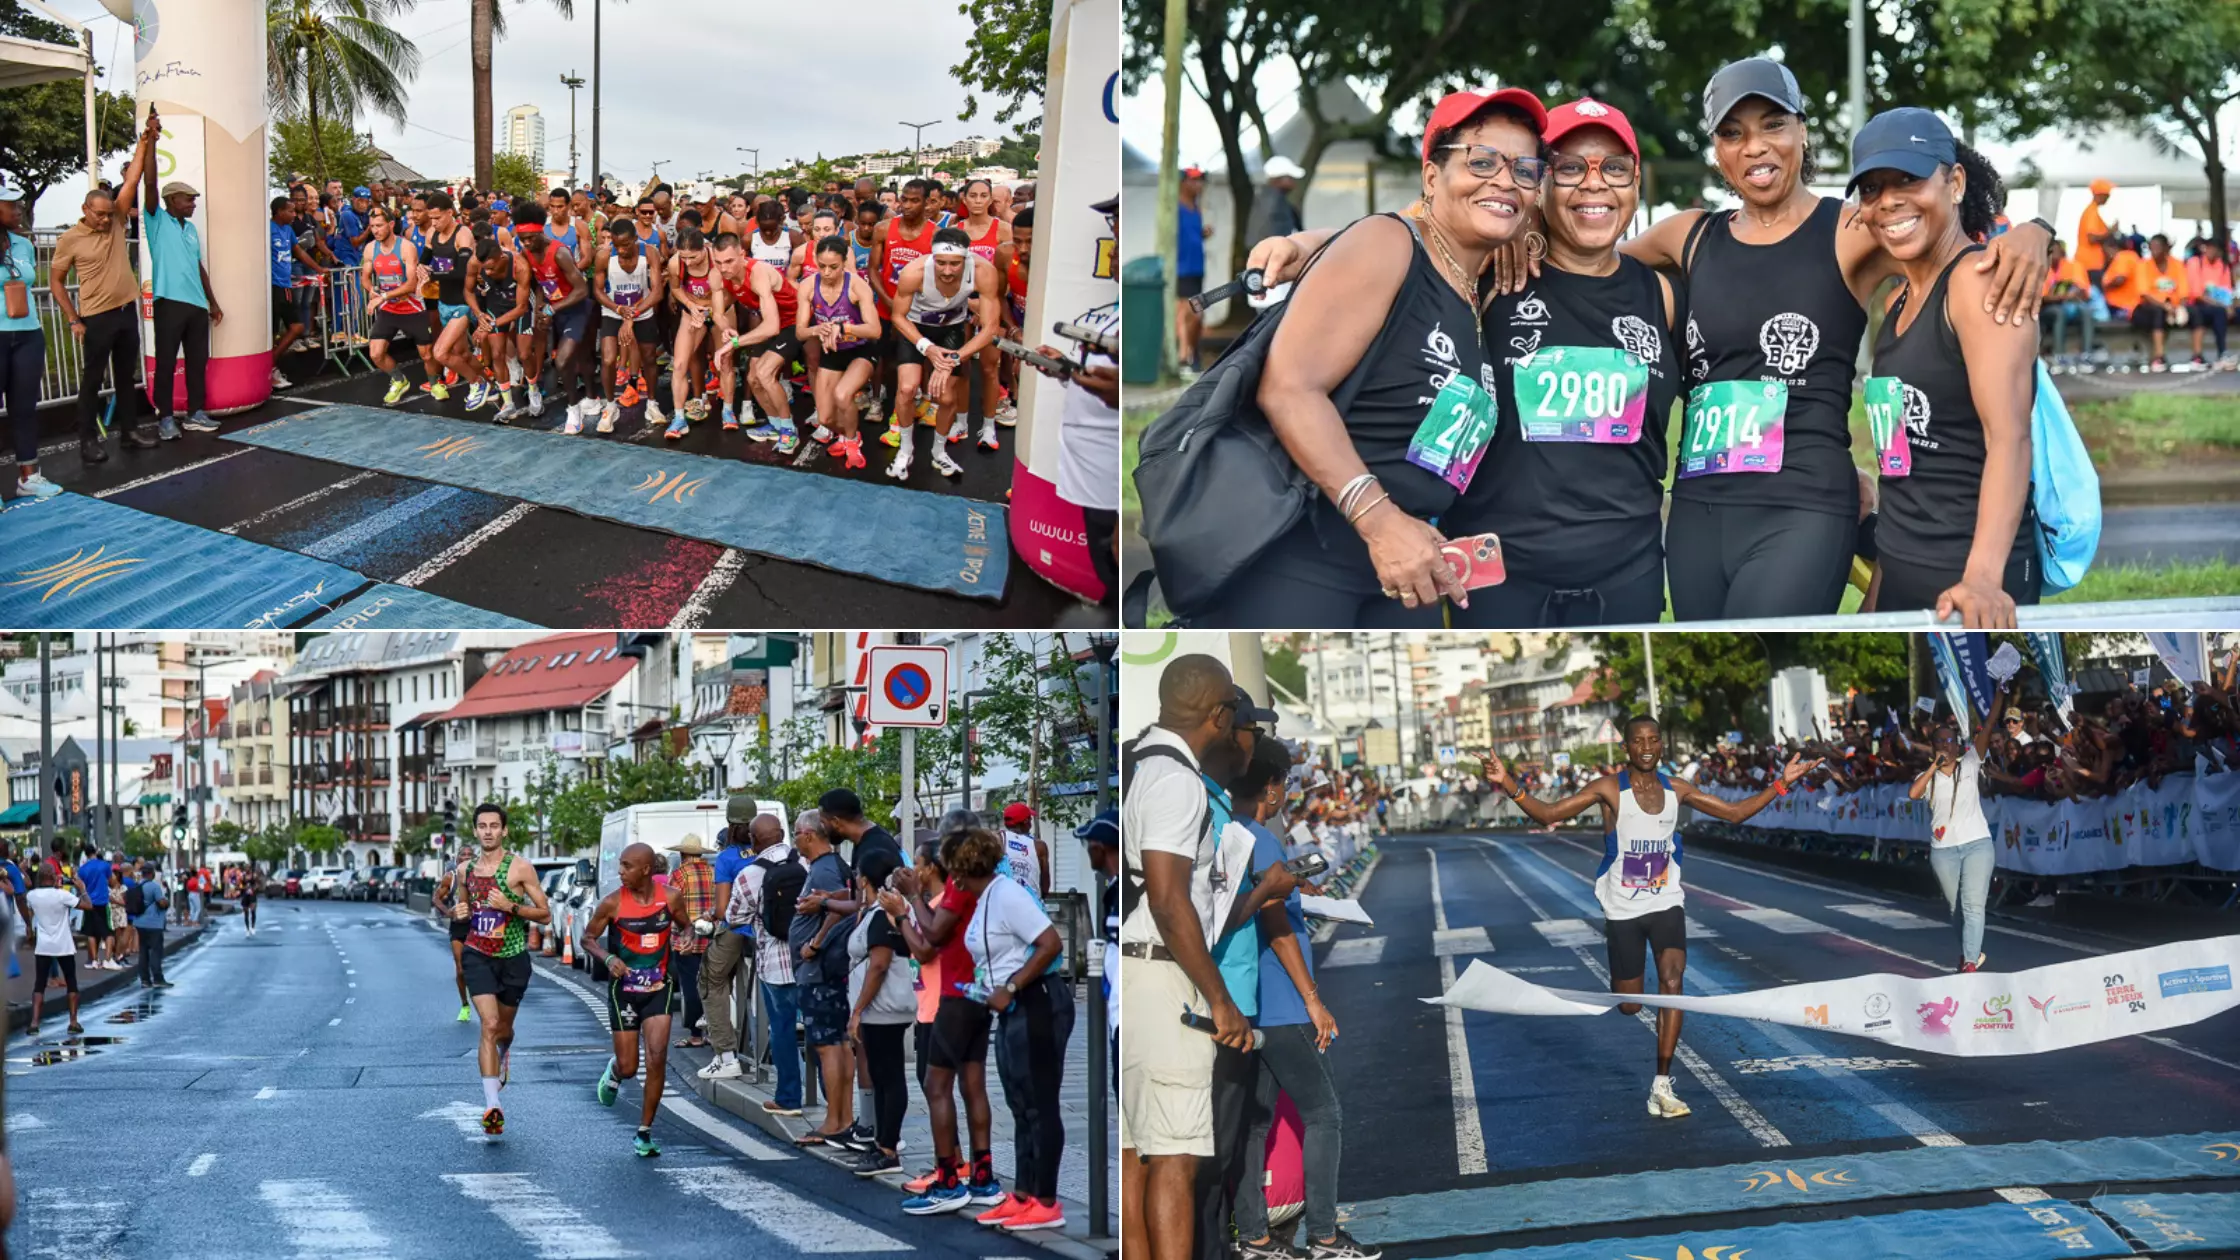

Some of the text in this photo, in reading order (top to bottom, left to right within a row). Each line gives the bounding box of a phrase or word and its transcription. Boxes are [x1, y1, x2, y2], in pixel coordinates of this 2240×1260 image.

[1624, 337, 1660, 363] BCT
[1768, 346, 1811, 373] BCT
[1536, 370, 1628, 419] 2980
[1691, 403, 1763, 453] 2914
[1630, 839, 1668, 852] VIRTUS
[1644, 861, 1652, 880] 1
[477, 917, 496, 932] 117
[2162, 976, 2188, 988] Active
[2195, 972, 2229, 986] Sportive
[2105, 983, 2136, 998] TERRE
[2106, 991, 2144, 1005] DE JEUX
[2128, 1000, 2147, 1013] 24
[1972, 1022, 2015, 1030] SPORTIVE
